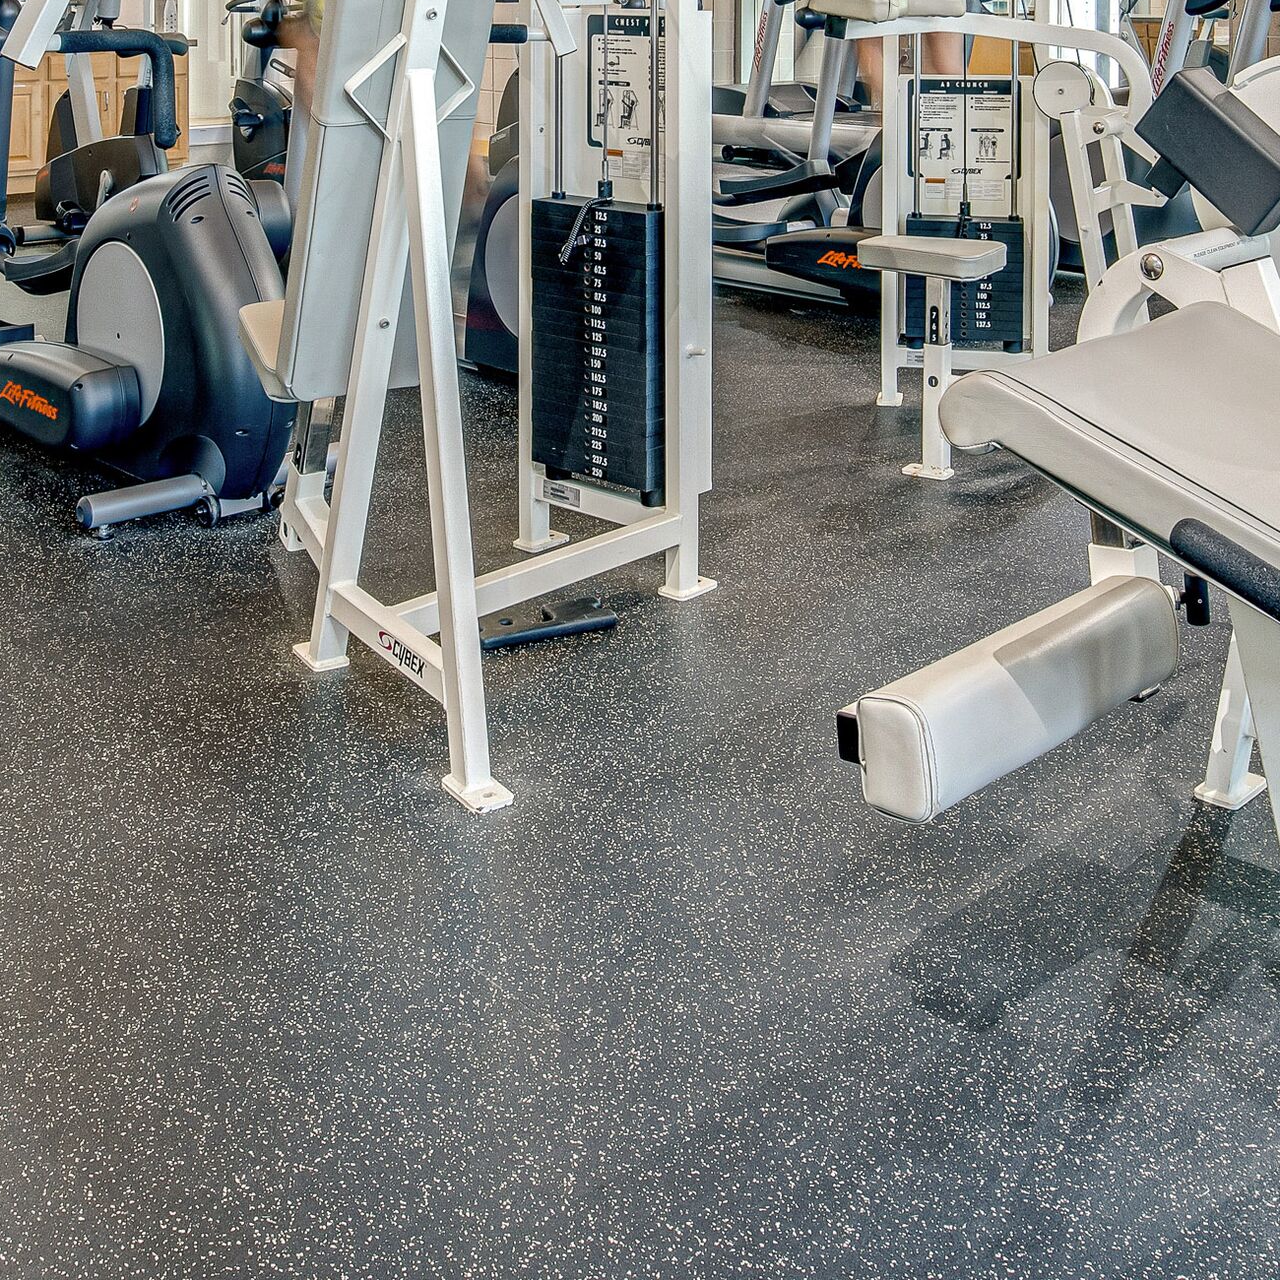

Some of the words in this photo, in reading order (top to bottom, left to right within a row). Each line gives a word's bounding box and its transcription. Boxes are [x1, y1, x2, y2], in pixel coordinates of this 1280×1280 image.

[615, 18, 640, 27] CHEST
[595, 211, 608, 221] 12.5
[594, 225, 602, 234] 25
[979, 222, 992, 230] 12.5
[593, 238, 607, 248] 37.5
[594, 251, 602, 261] 50
[593, 265, 607, 275] 62.5
[593, 278, 602, 288] 75
[979, 282, 993, 291] 87.5
[977, 292, 988, 300] 100
[591, 305, 602, 315] 100
[975, 301, 991, 310] 112.5
[931, 311, 937, 320] 7
[975, 312, 987, 320] 125
[590, 318, 606, 330] 112.5
[931, 322, 937, 331] 6
[591, 332, 602, 342] 125
[931, 334, 937, 342] 5
[591, 346, 607, 358] 137.5
[590, 358, 601, 369] 150
[591, 372, 606, 384] 162.5
[592, 386, 602, 396] 175
[592, 400, 608, 412] 187.5
[592, 413, 603, 424] 200
[591, 427, 607, 439] 212.5
[591, 440, 602, 450] 225
[592, 454, 608, 467] 237.5
[592, 467, 603, 478] 250
[392, 639, 425, 679] CYBEX
